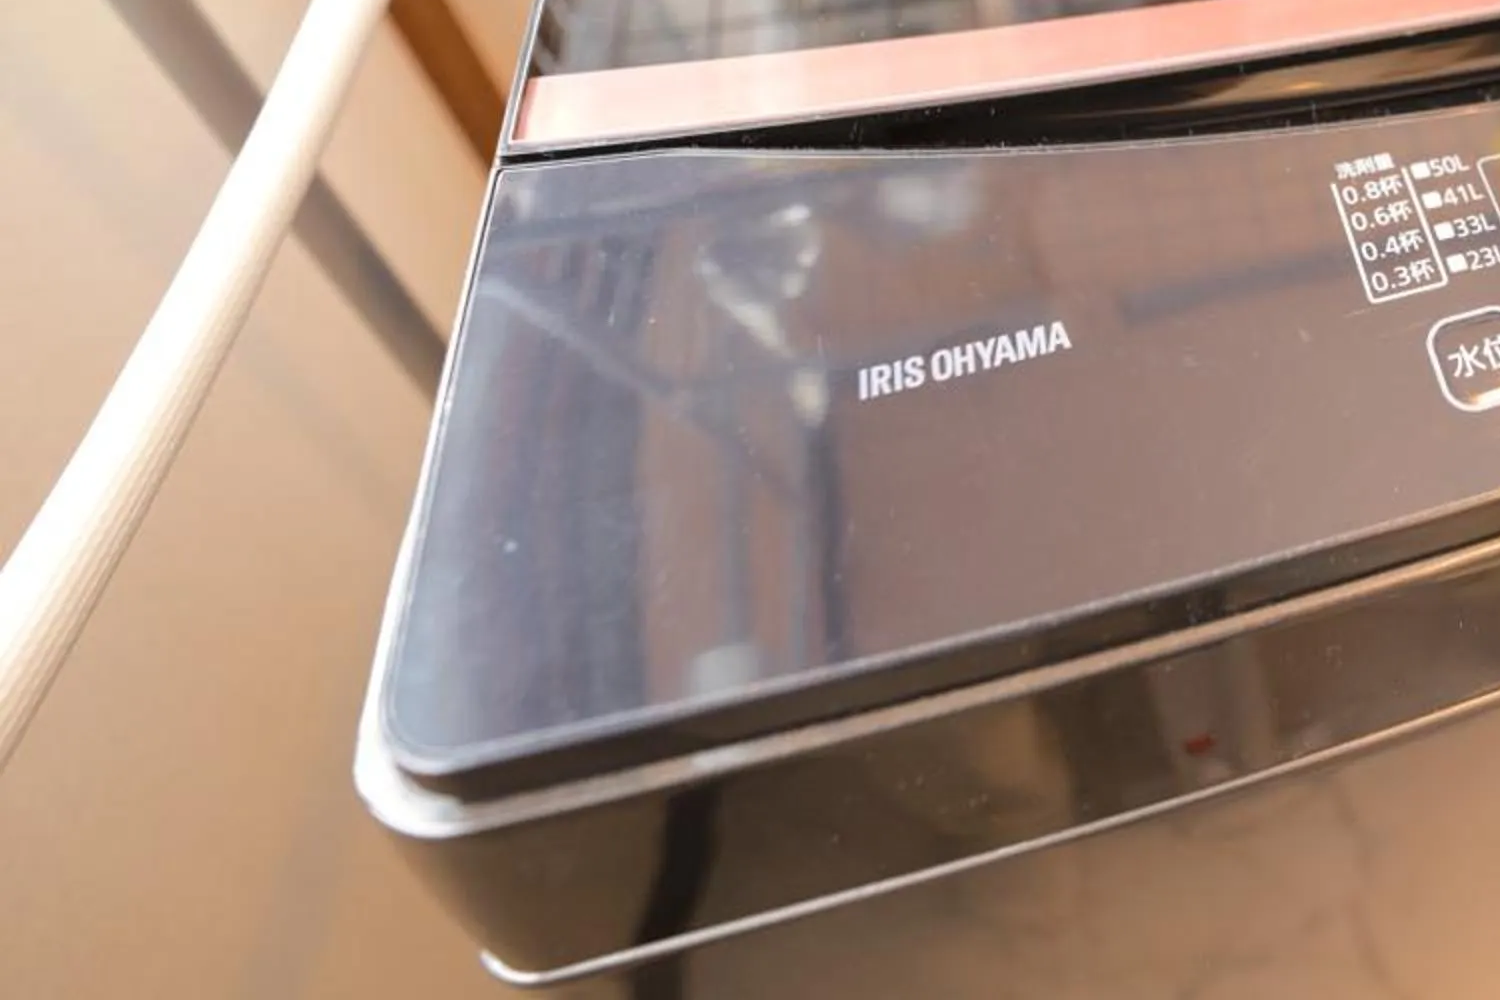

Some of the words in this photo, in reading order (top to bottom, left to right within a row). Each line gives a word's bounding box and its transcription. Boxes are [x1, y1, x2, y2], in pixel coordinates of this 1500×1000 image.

[1428, 153, 1471, 178] 50L
[1341, 173, 1404, 205] 0.8杯
[1442, 182, 1486, 206] 41L
[1350, 199, 1413, 231] 0.6杯
[1452, 212, 1497, 238] 33L
[1360, 228, 1425, 261] 0.4杯
[1371, 257, 1436, 292] 0.3杯
[858, 355, 926, 401] IRIS
[930, 319, 1074, 383] OHYAMA
